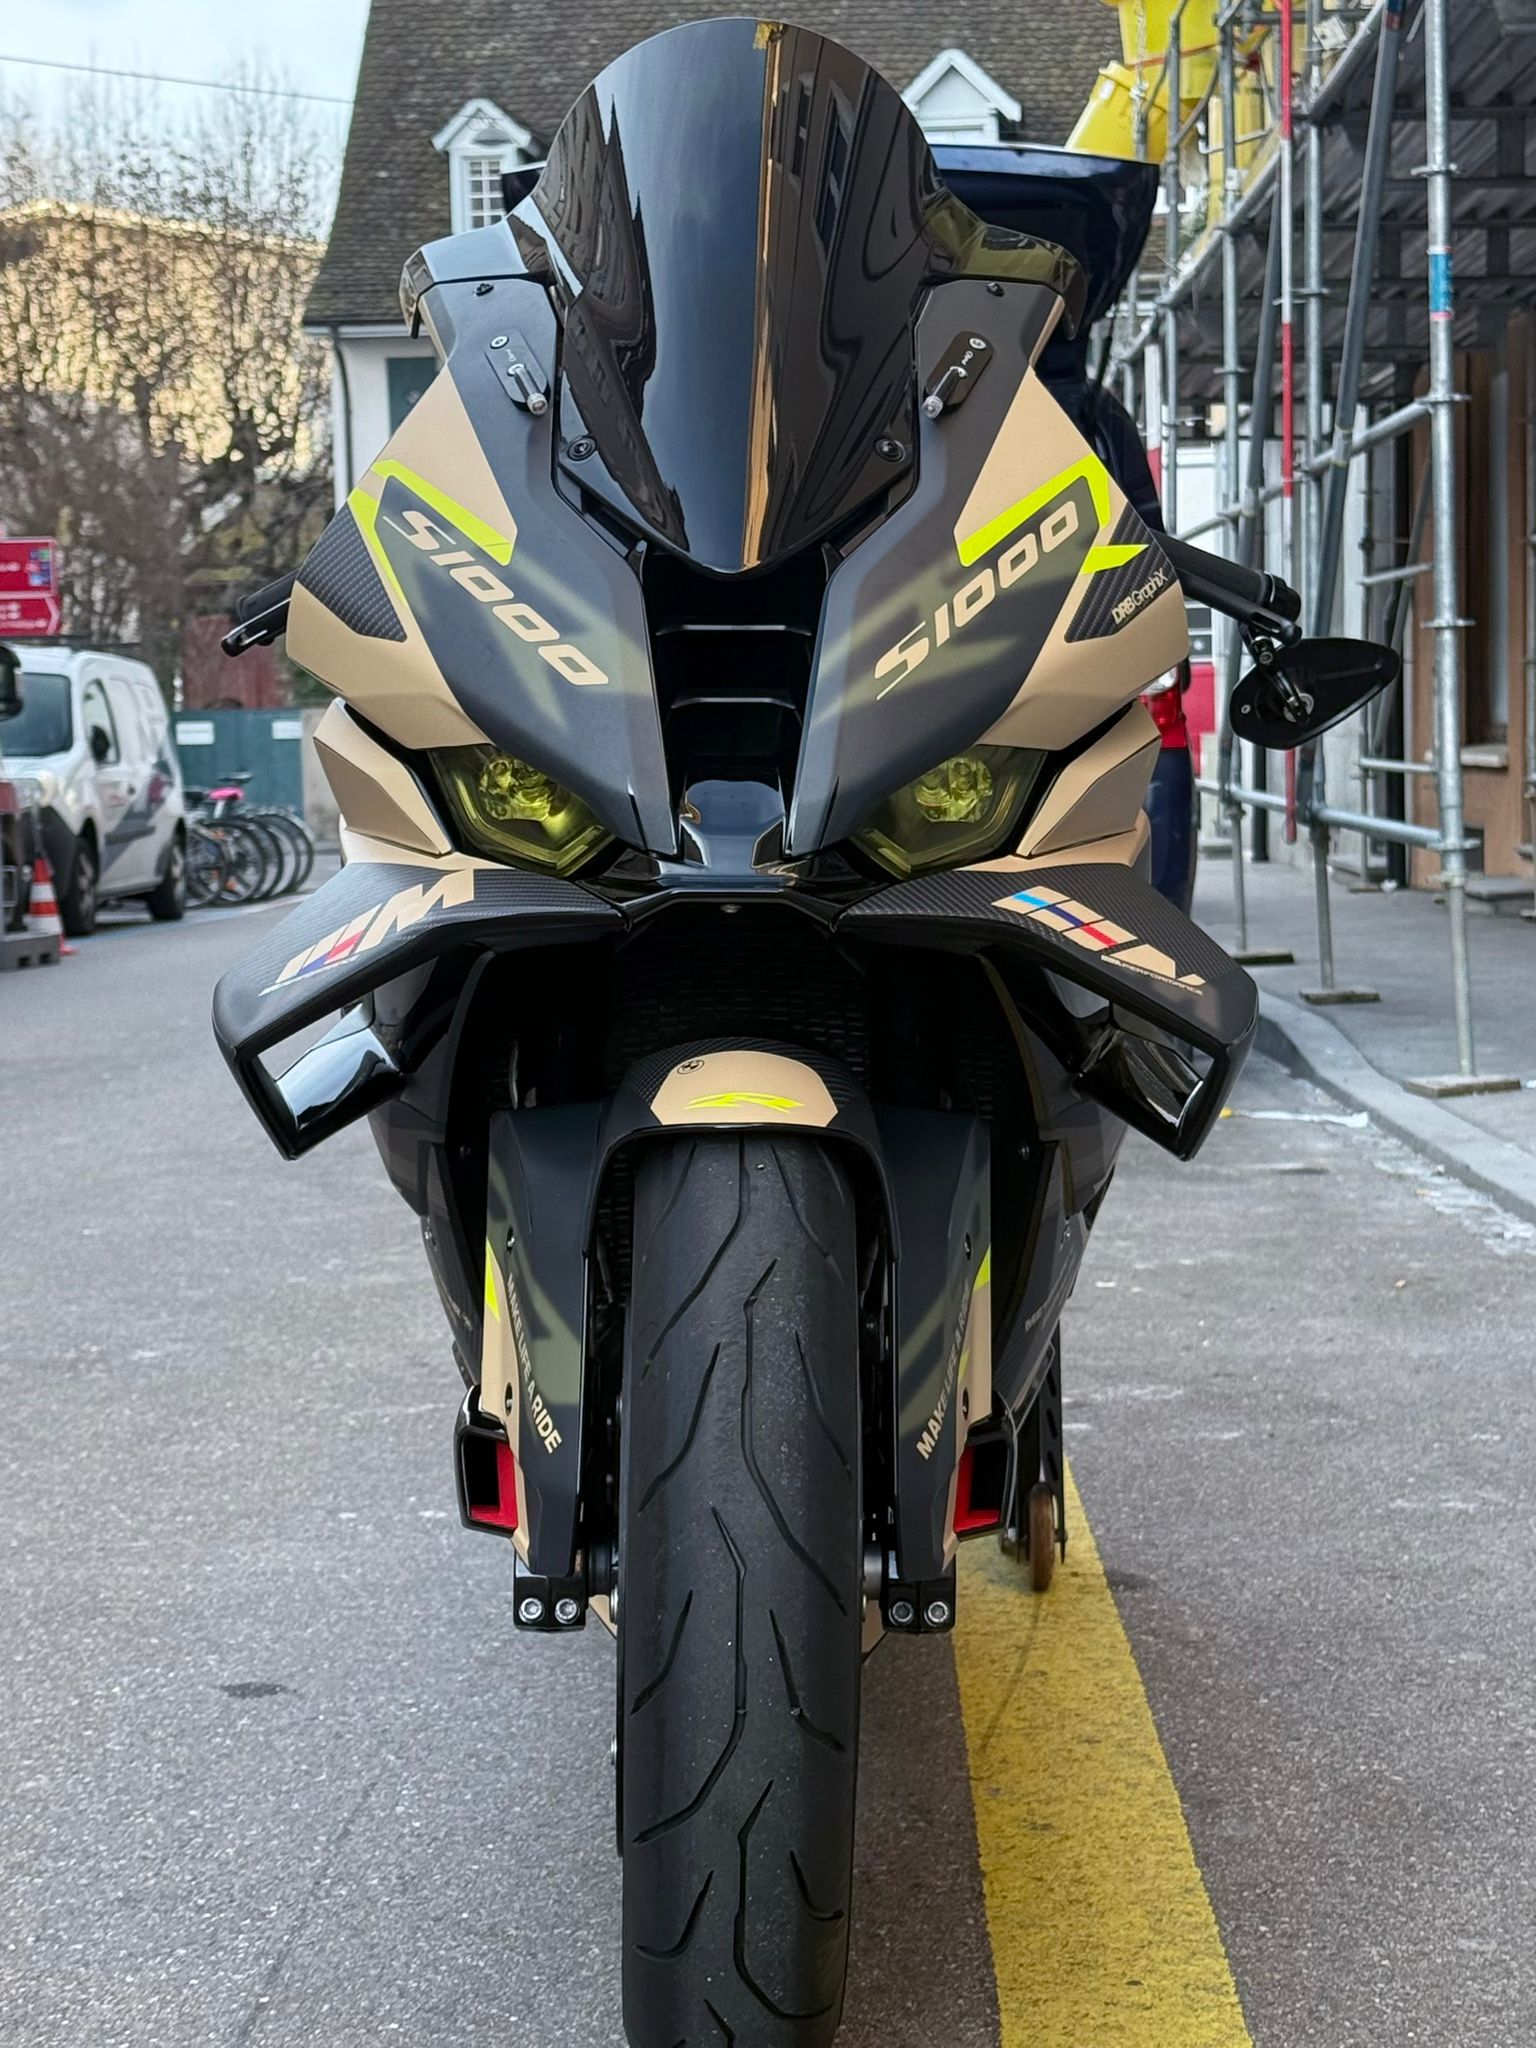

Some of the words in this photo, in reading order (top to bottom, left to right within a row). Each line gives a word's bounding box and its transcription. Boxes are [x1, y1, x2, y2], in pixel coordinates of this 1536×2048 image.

[383, 510, 609, 686] S1000
[874, 501, 1079, 700] S1000
[507, 1272, 522, 1334] MAKE
[518, 1333, 532, 1381] LIFE
[527, 1379, 536, 1400] A
[531, 1394, 562, 1454] RIDE
[916, 1390, 948, 1460] MAKE
